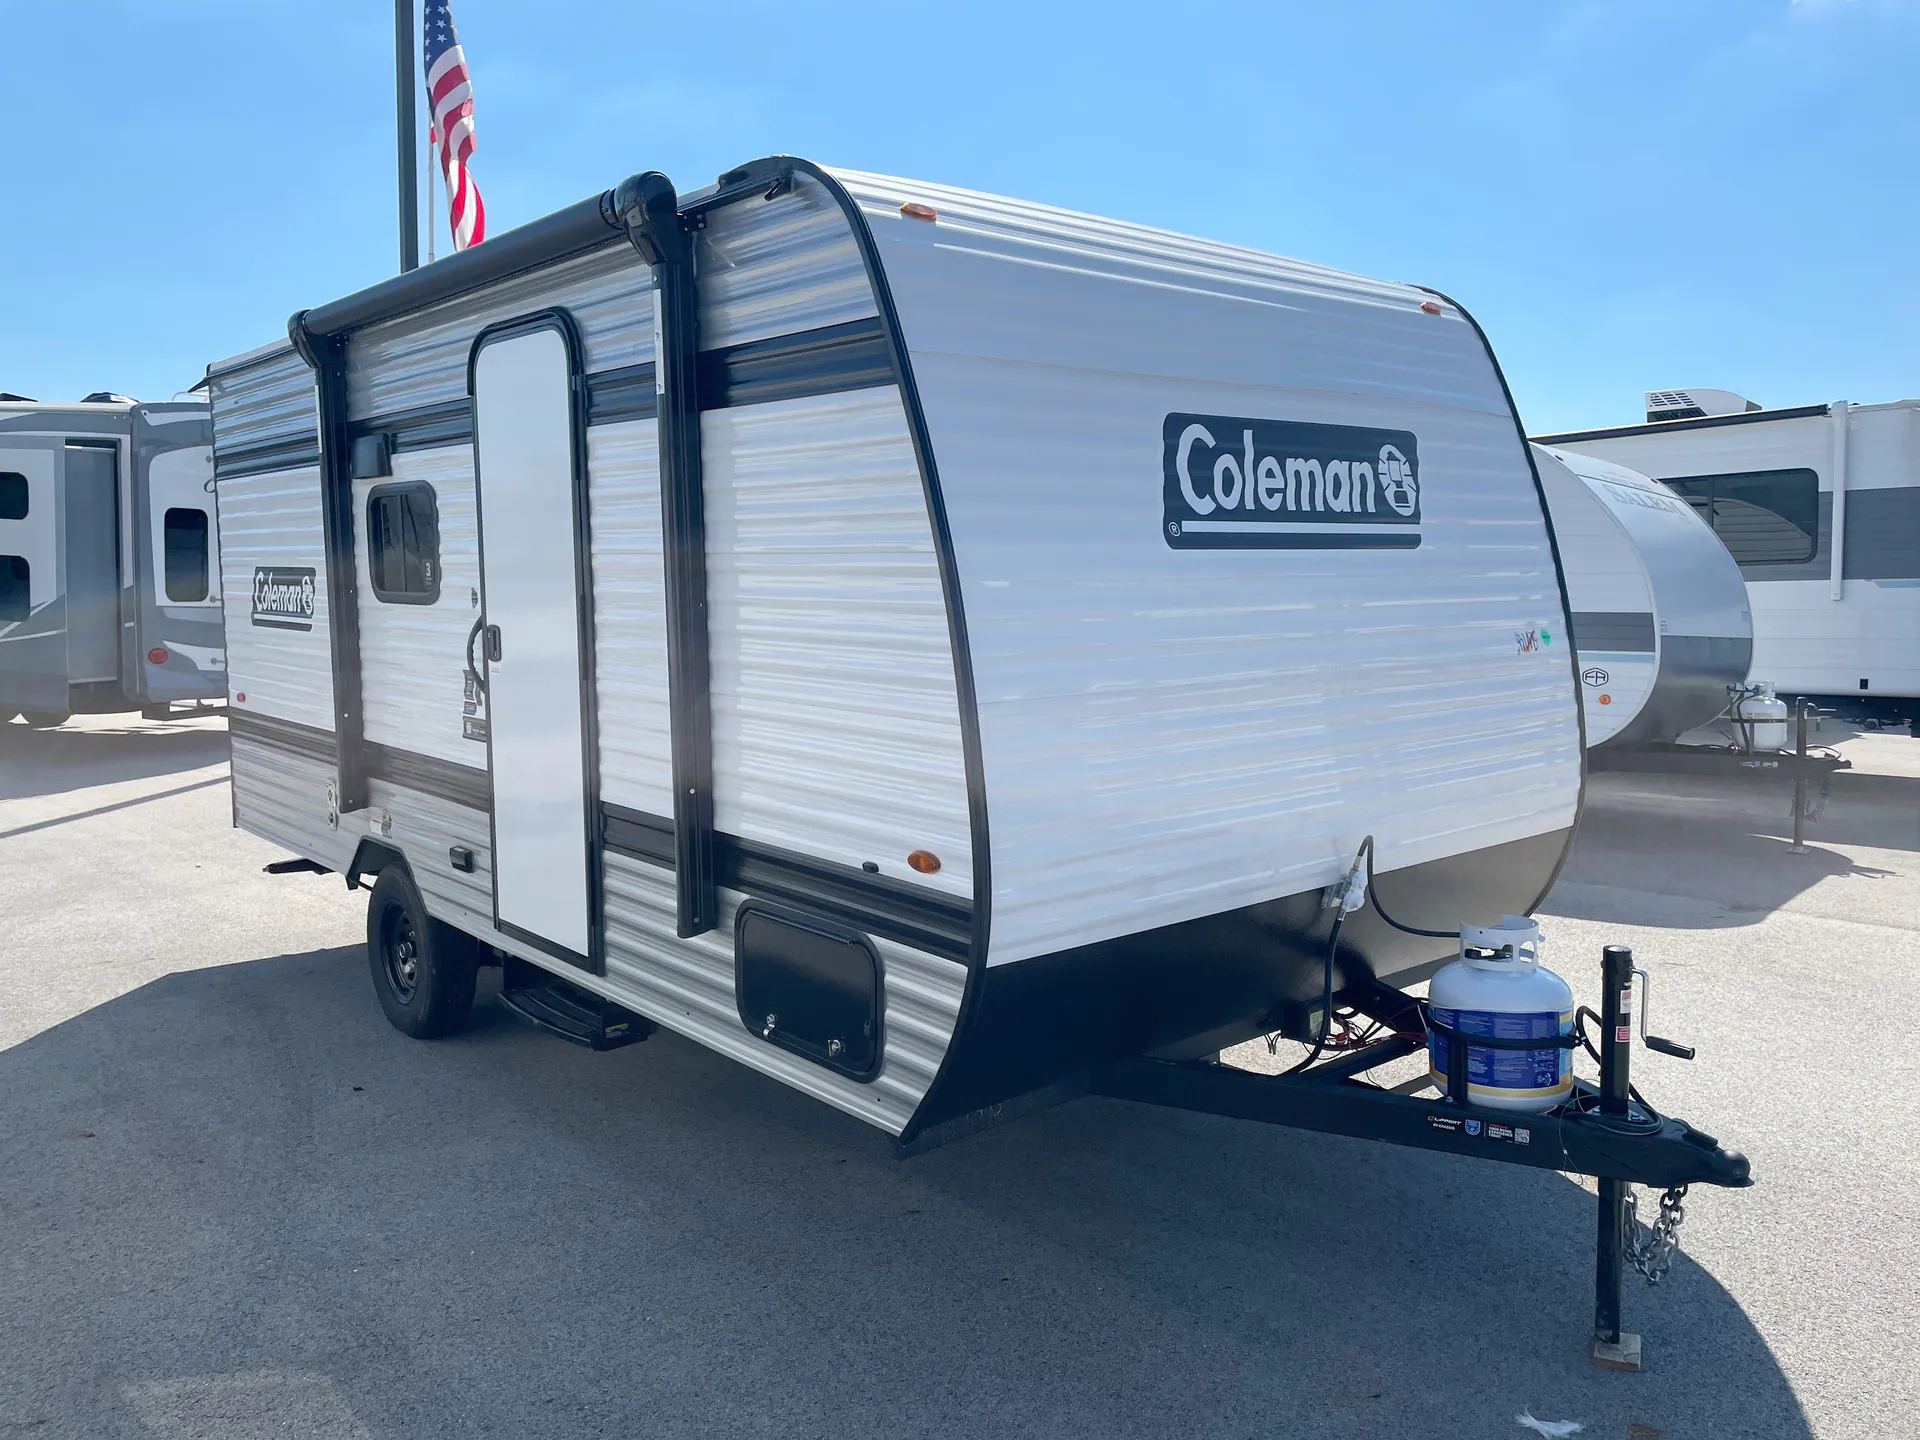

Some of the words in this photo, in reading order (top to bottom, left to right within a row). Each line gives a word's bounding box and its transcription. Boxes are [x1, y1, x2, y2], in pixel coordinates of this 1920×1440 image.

[1176, 423, 1376, 516] Coleman
[1601, 483, 1687, 516] SALEM
[254, 571, 302, 613] Coleman
